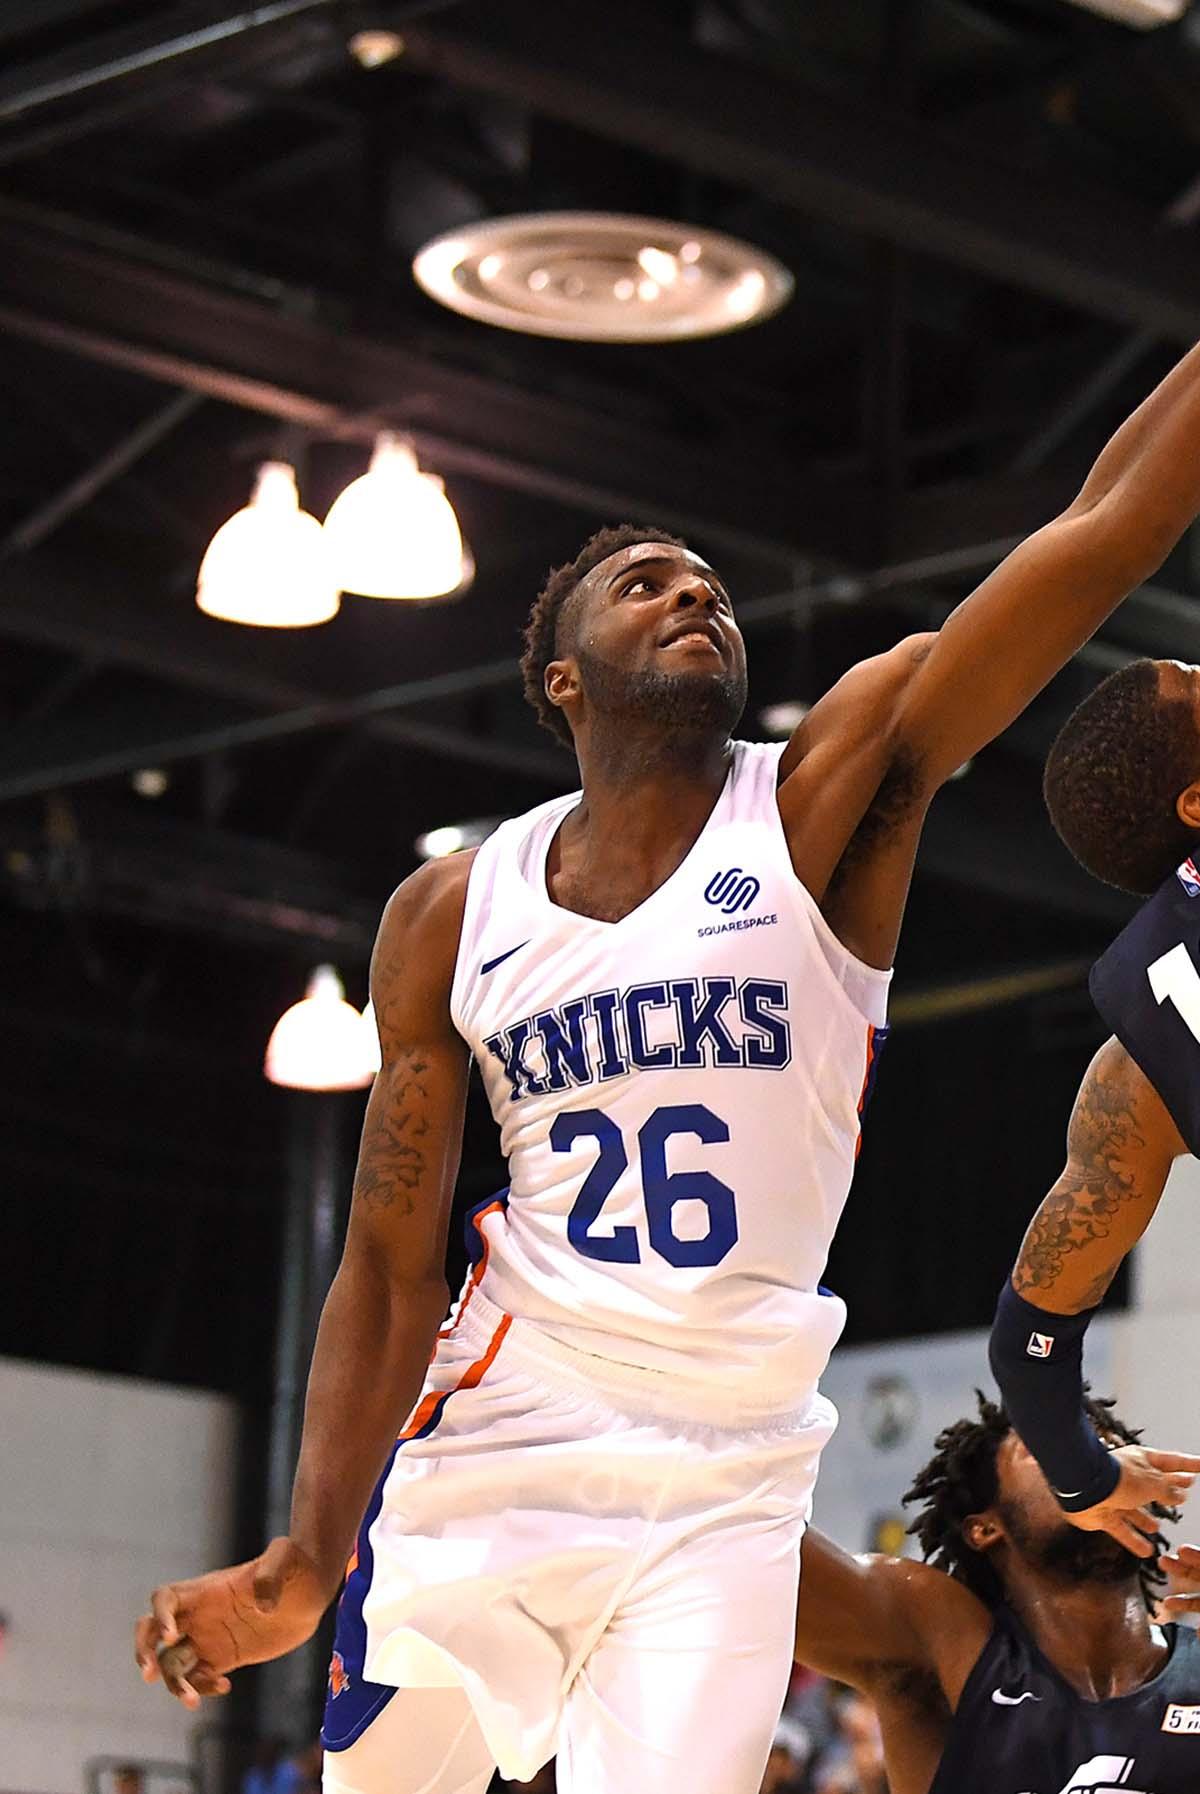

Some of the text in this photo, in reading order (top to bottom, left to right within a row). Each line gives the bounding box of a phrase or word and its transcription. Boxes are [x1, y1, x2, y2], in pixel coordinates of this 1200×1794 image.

[697, 914, 778, 938] SQUARESPACE
[482, 976, 792, 1101] KNICKS
[549, 1103, 739, 1268] 26
[1169, 1709, 1183, 1729] 5
